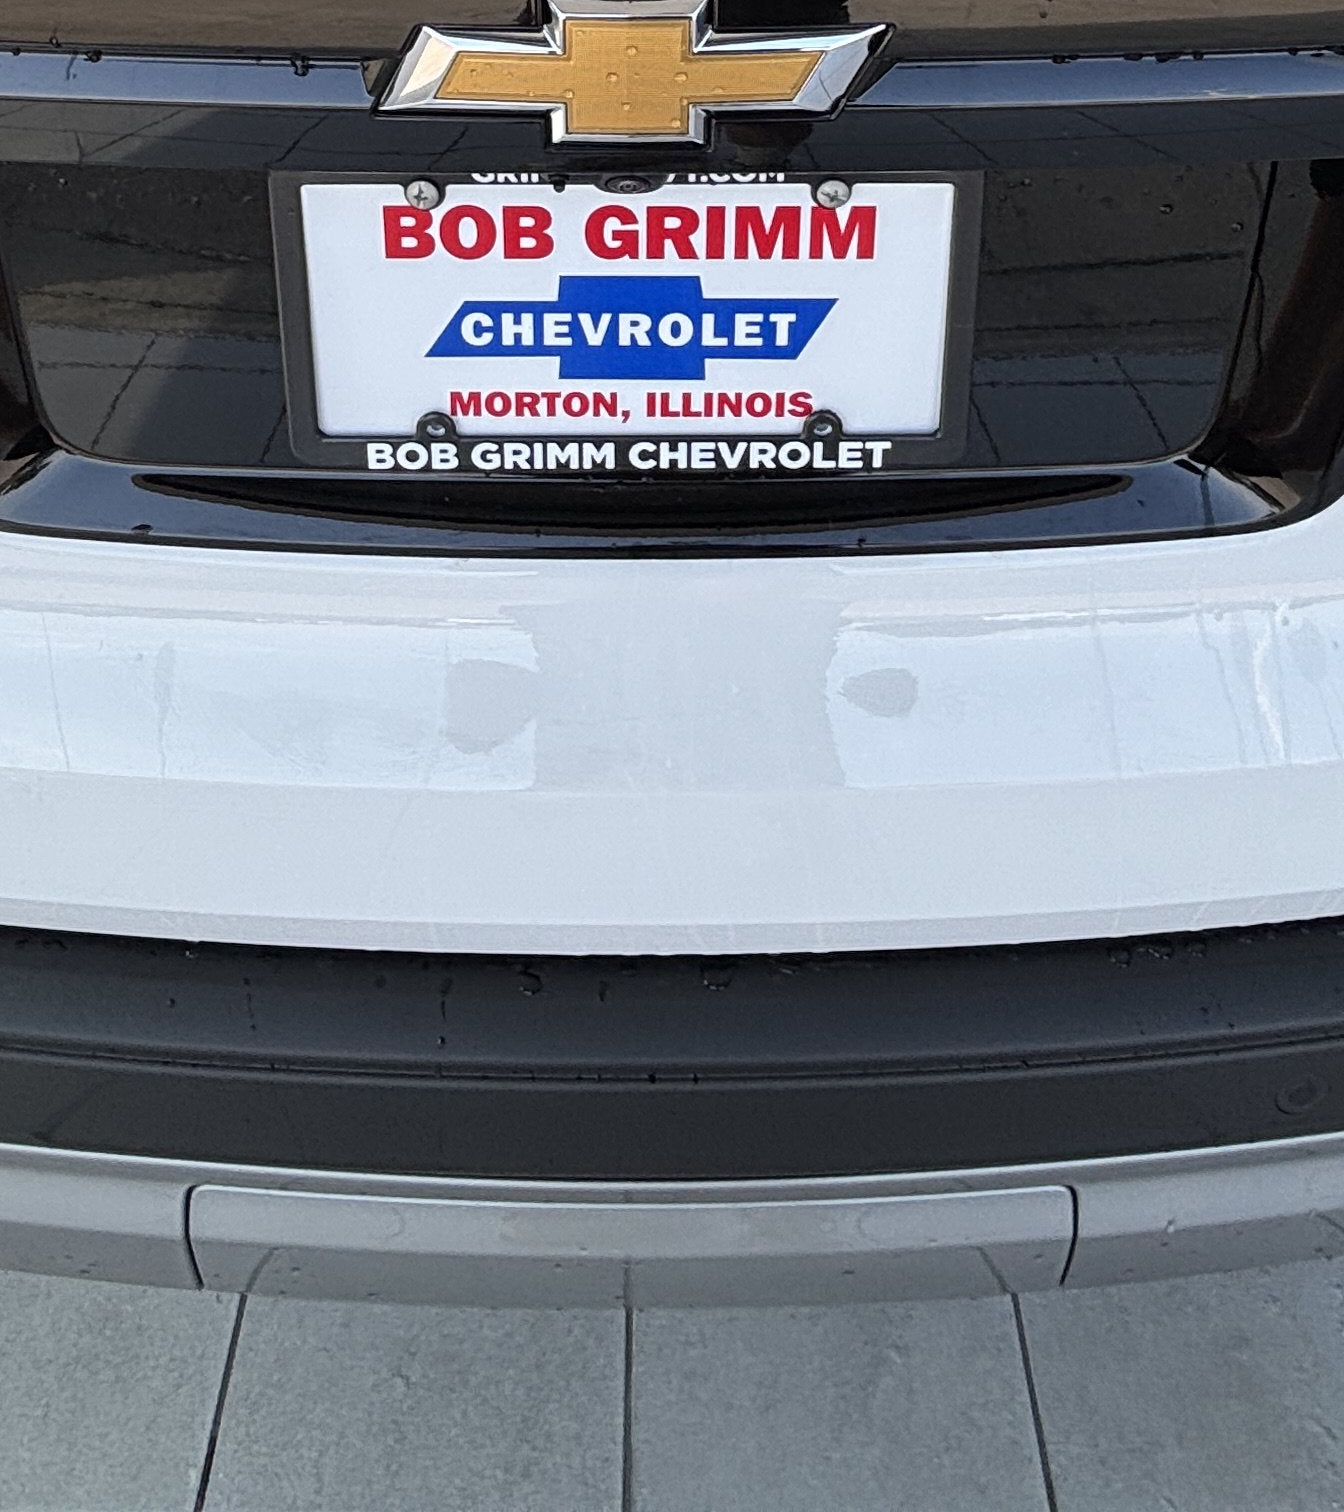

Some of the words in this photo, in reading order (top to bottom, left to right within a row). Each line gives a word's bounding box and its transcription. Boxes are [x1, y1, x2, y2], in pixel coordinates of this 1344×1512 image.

[383, 205, 553, 260] BOB
[584, 205, 876, 260] GRIMM
[461, 312, 797, 347] CHEVROLET
[450, 392, 631, 424] MORTON,
[646, 392, 814, 418] ILLINOIS
[366, 441, 459, 470] BOB
[470, 441, 616, 470] GRIMM
[628, 440, 892, 470] CHEVROLET
